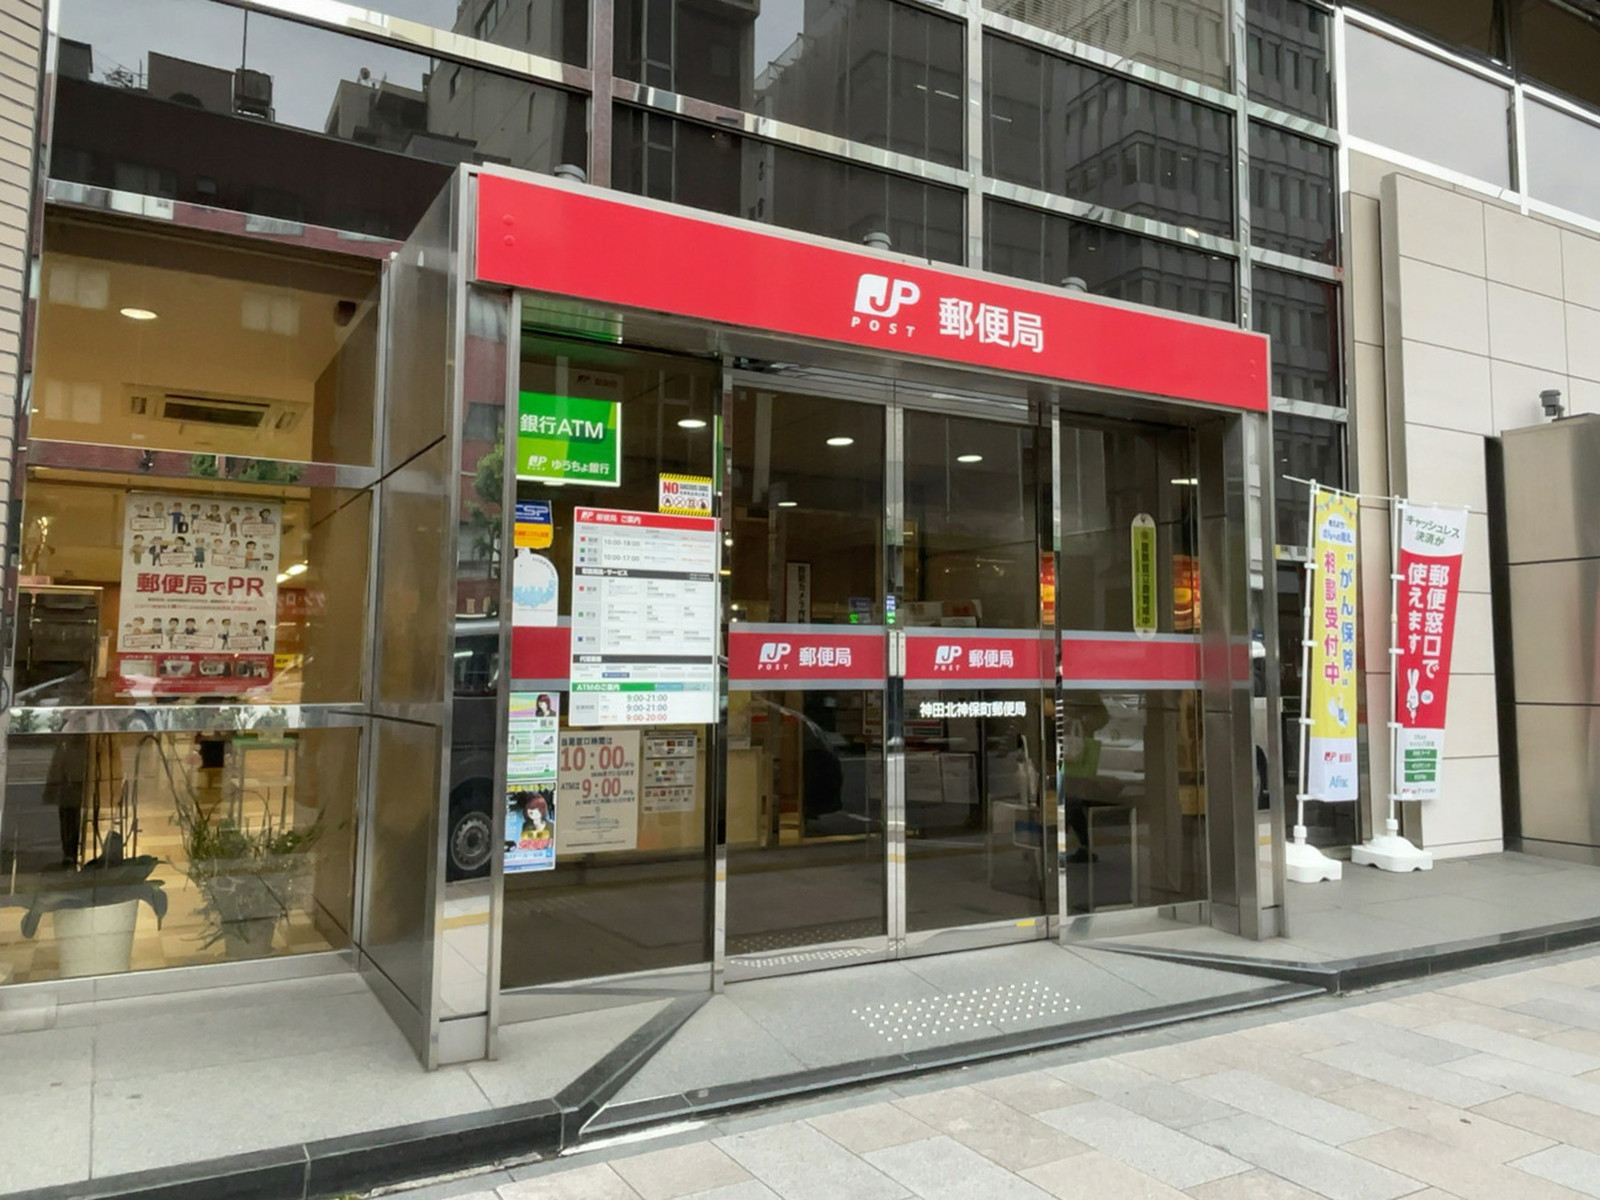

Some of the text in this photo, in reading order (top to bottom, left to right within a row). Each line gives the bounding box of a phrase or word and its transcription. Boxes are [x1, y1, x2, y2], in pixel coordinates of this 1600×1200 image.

[850, 316, 916, 338] POST
[939, 298, 1044, 353] 郵便局
[519, 413, 604, 440] 銀行ATM
[551, 460, 610, 475] ゆうちょ銀行
[663, 481, 679, 495] NO
[1405, 514, 1460, 539] キャッシュレス
[1415, 530, 1446, 547] 決済が
[136, 573, 265, 597] 郵便局でPR
[1323, 551, 1340, 685] 相談受付中
[1407, 562, 1428, 655] 使えます
[1422, 564, 1450, 679] 郵便窓口で
[757, 663, 789, 671] POST
[799, 646, 852, 668] 郵便局
[968, 649, 1014, 668] 郵便局
[626, 694, 668, 702] 9:00-21:00
[919, 701, 1027, 718] 神田北神保町郵便局
[560, 745, 625, 771] 10:00
[582, 777, 622, 799] 9:00
